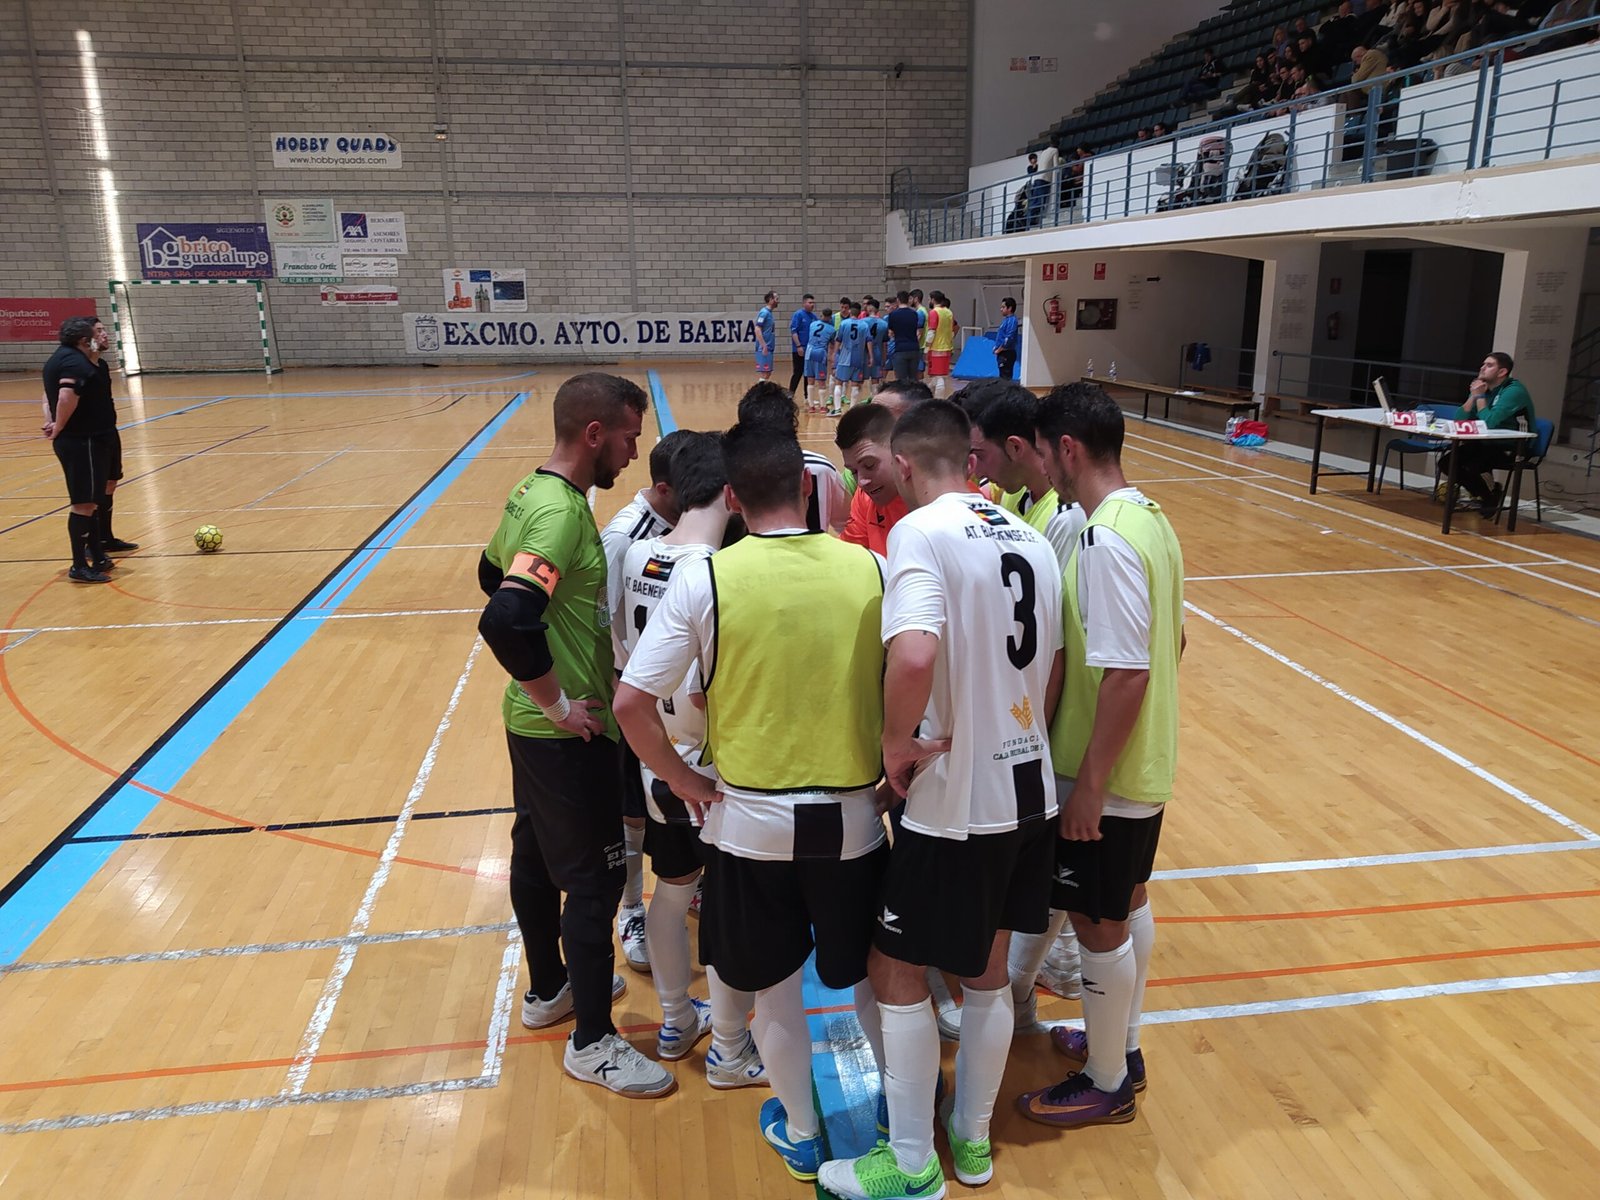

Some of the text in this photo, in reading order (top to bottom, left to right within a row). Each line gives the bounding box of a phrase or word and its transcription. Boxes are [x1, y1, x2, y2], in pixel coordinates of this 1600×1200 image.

[276, 137, 329, 152] HOBBY
[289, 156, 388, 165] www.hobbyquads.com
[343, 226, 364, 236] AXA
[179, 236, 230, 253] brico
[181, 248, 268, 268] guadalupe
[283, 262, 318, 270] Francisco
[320, 262, 337, 271] Ortiz
[0, 309, 49, 318] Diputación
[443, 320, 756, 346] EXCMO. AYTO. DE BAENA
[813, 323, 825, 337] 2
[850, 323, 858, 340] 5
[870, 322, 878, 337] 4
[964, 525, 982, 539] AT.
[1000, 552, 1037, 671] 3
[1002, 734, 1040, 749] FUNDACI
